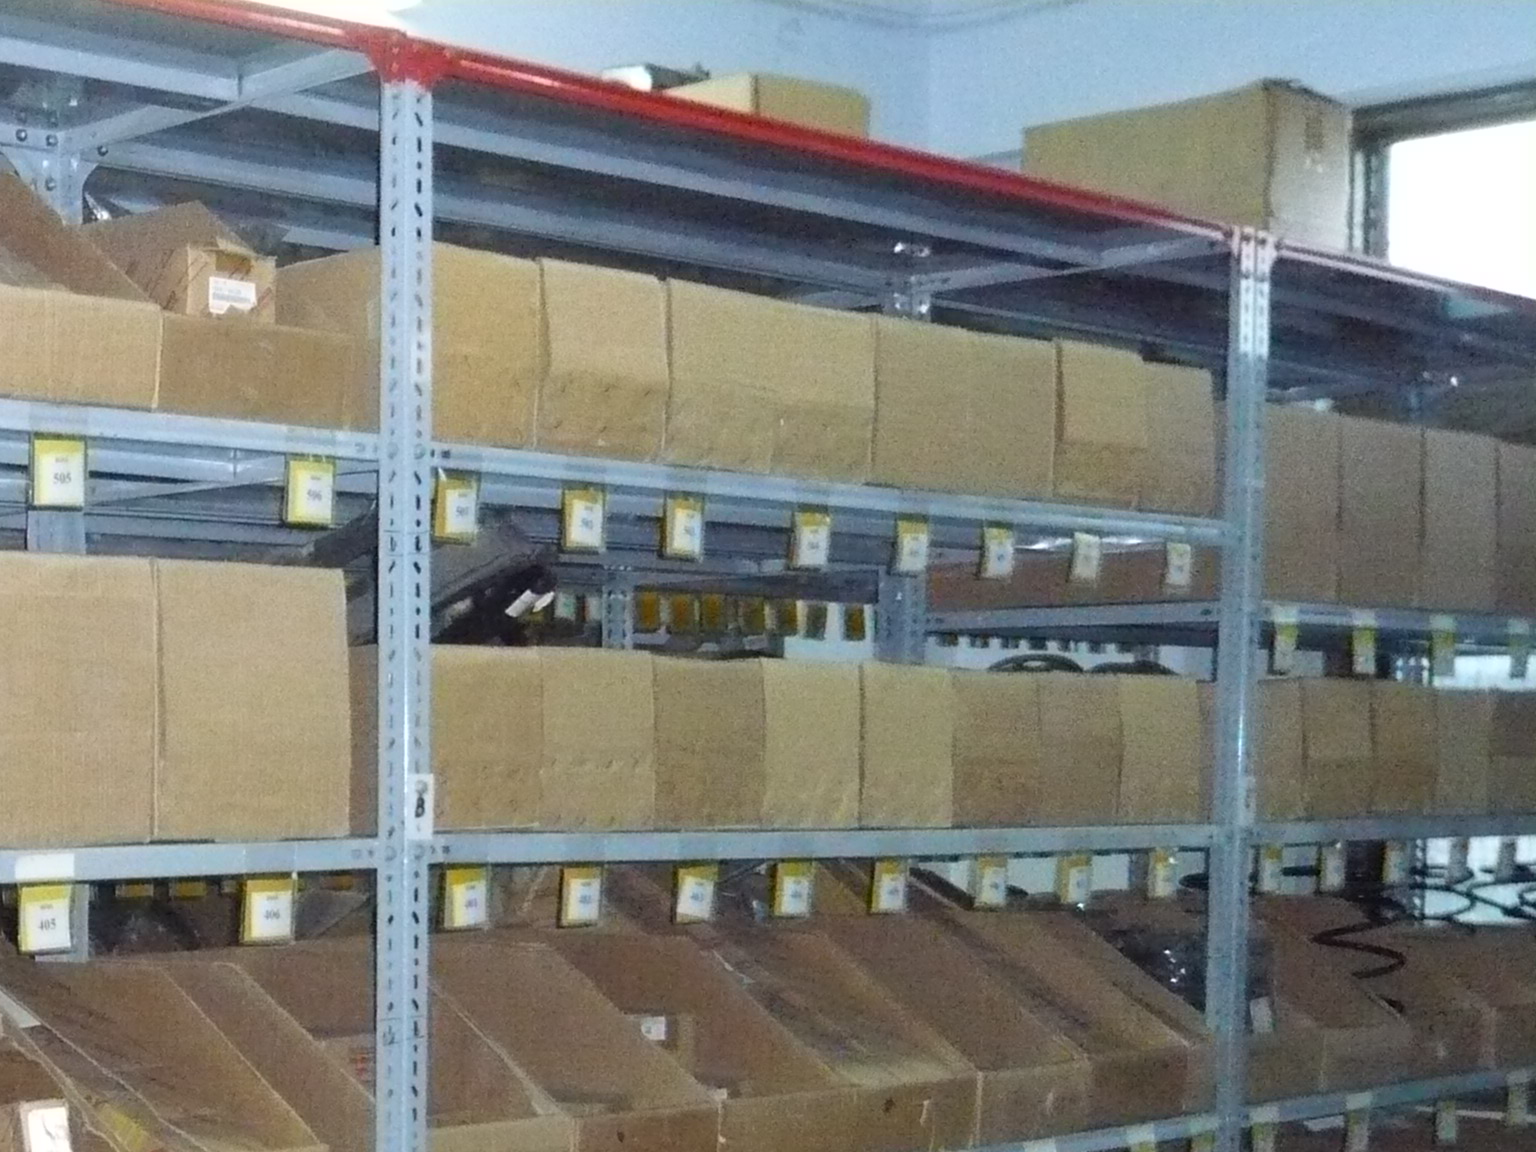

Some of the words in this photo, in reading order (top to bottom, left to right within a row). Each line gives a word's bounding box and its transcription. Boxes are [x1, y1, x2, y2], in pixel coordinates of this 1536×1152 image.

[52, 472, 73, 486] 505
[414, 796, 426, 818] B
[263, 907, 281, 921] 406
[37, 916, 58, 932] 405
